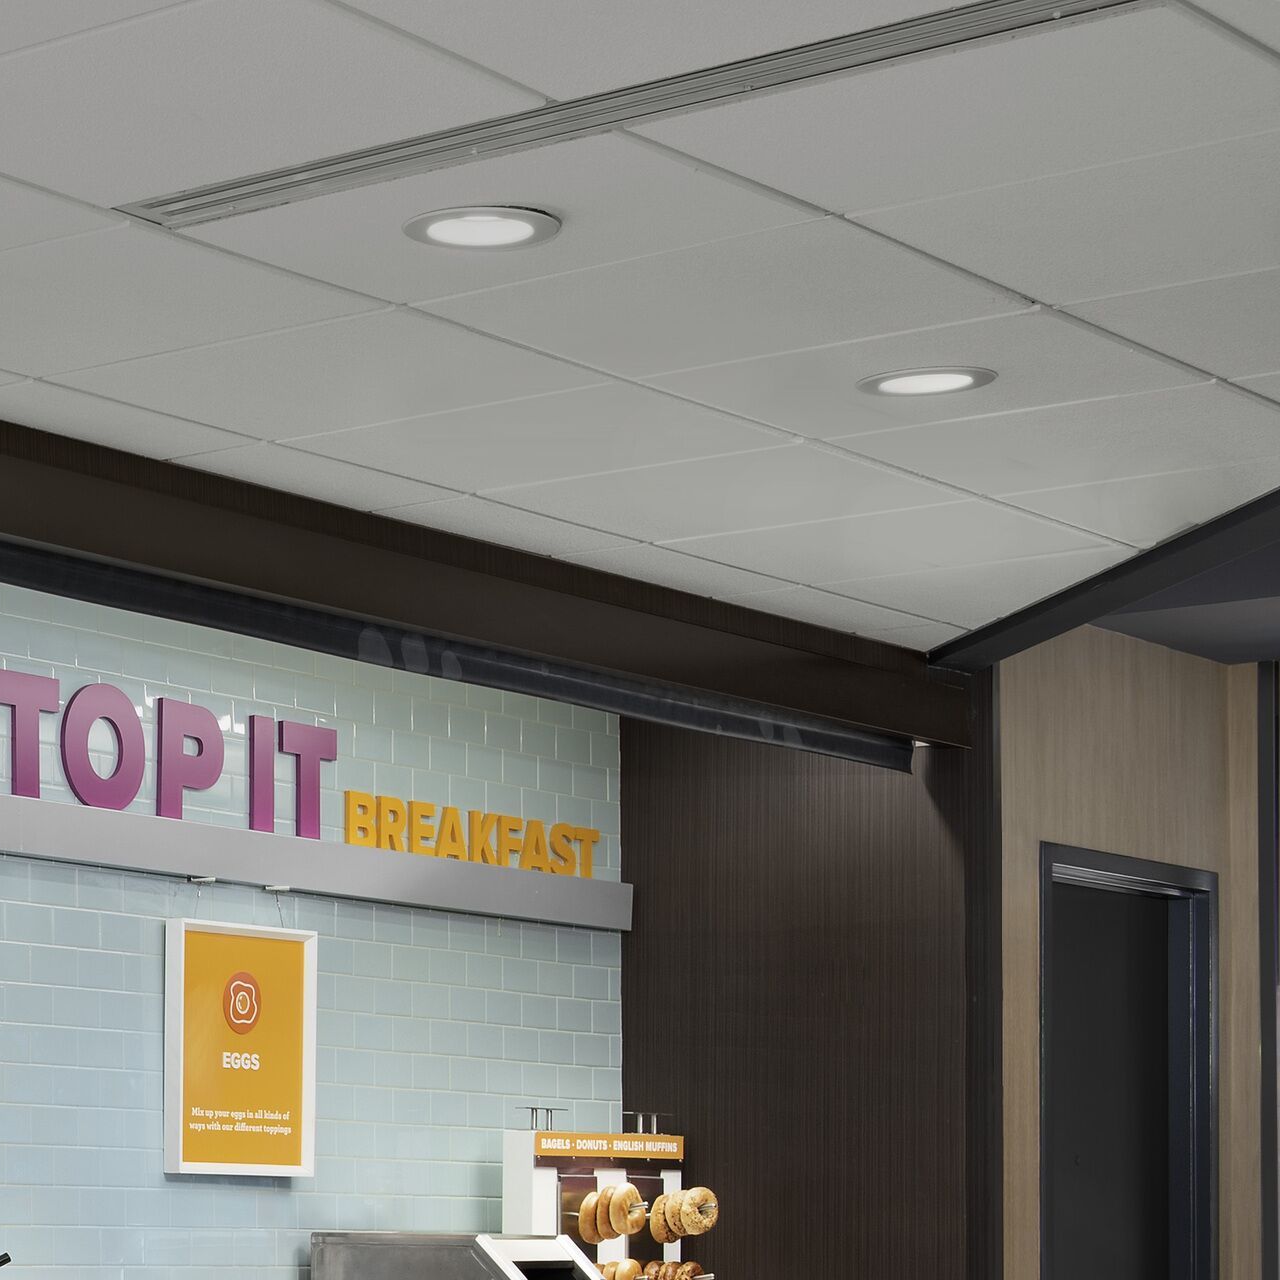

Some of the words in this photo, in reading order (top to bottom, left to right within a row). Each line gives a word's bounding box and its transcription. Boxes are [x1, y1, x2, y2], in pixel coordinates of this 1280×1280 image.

[248, 713, 338, 841] IT
[343, 789, 600, 880] BREAKFAST
[222, 1051, 260, 1071] EGGS
[192, 1107, 205, 1116] Mix
[205, 1110, 214, 1118] up
[214, 1110, 230, 1118] your
[230, 1111, 246, 1120] eggs
[247, 1110, 254, 1118] in
[254, 1110, 263, 1119] all
[264, 1110, 282, 1120] kinds
[282, 1111, 290, 1120] of
[189, 1122, 206, 1132] ways
[206, 1120, 221, 1131] with
[234, 1122, 262, 1132] different
[263, 1124, 292, 1136] toppings
[541, 1138, 571, 1150] BAGELS
[576, 1140, 608, 1150] DONUTS
[613, 1140, 644, 1152] ENGLISH
[645, 1142, 678, 1152] MUFFINS
